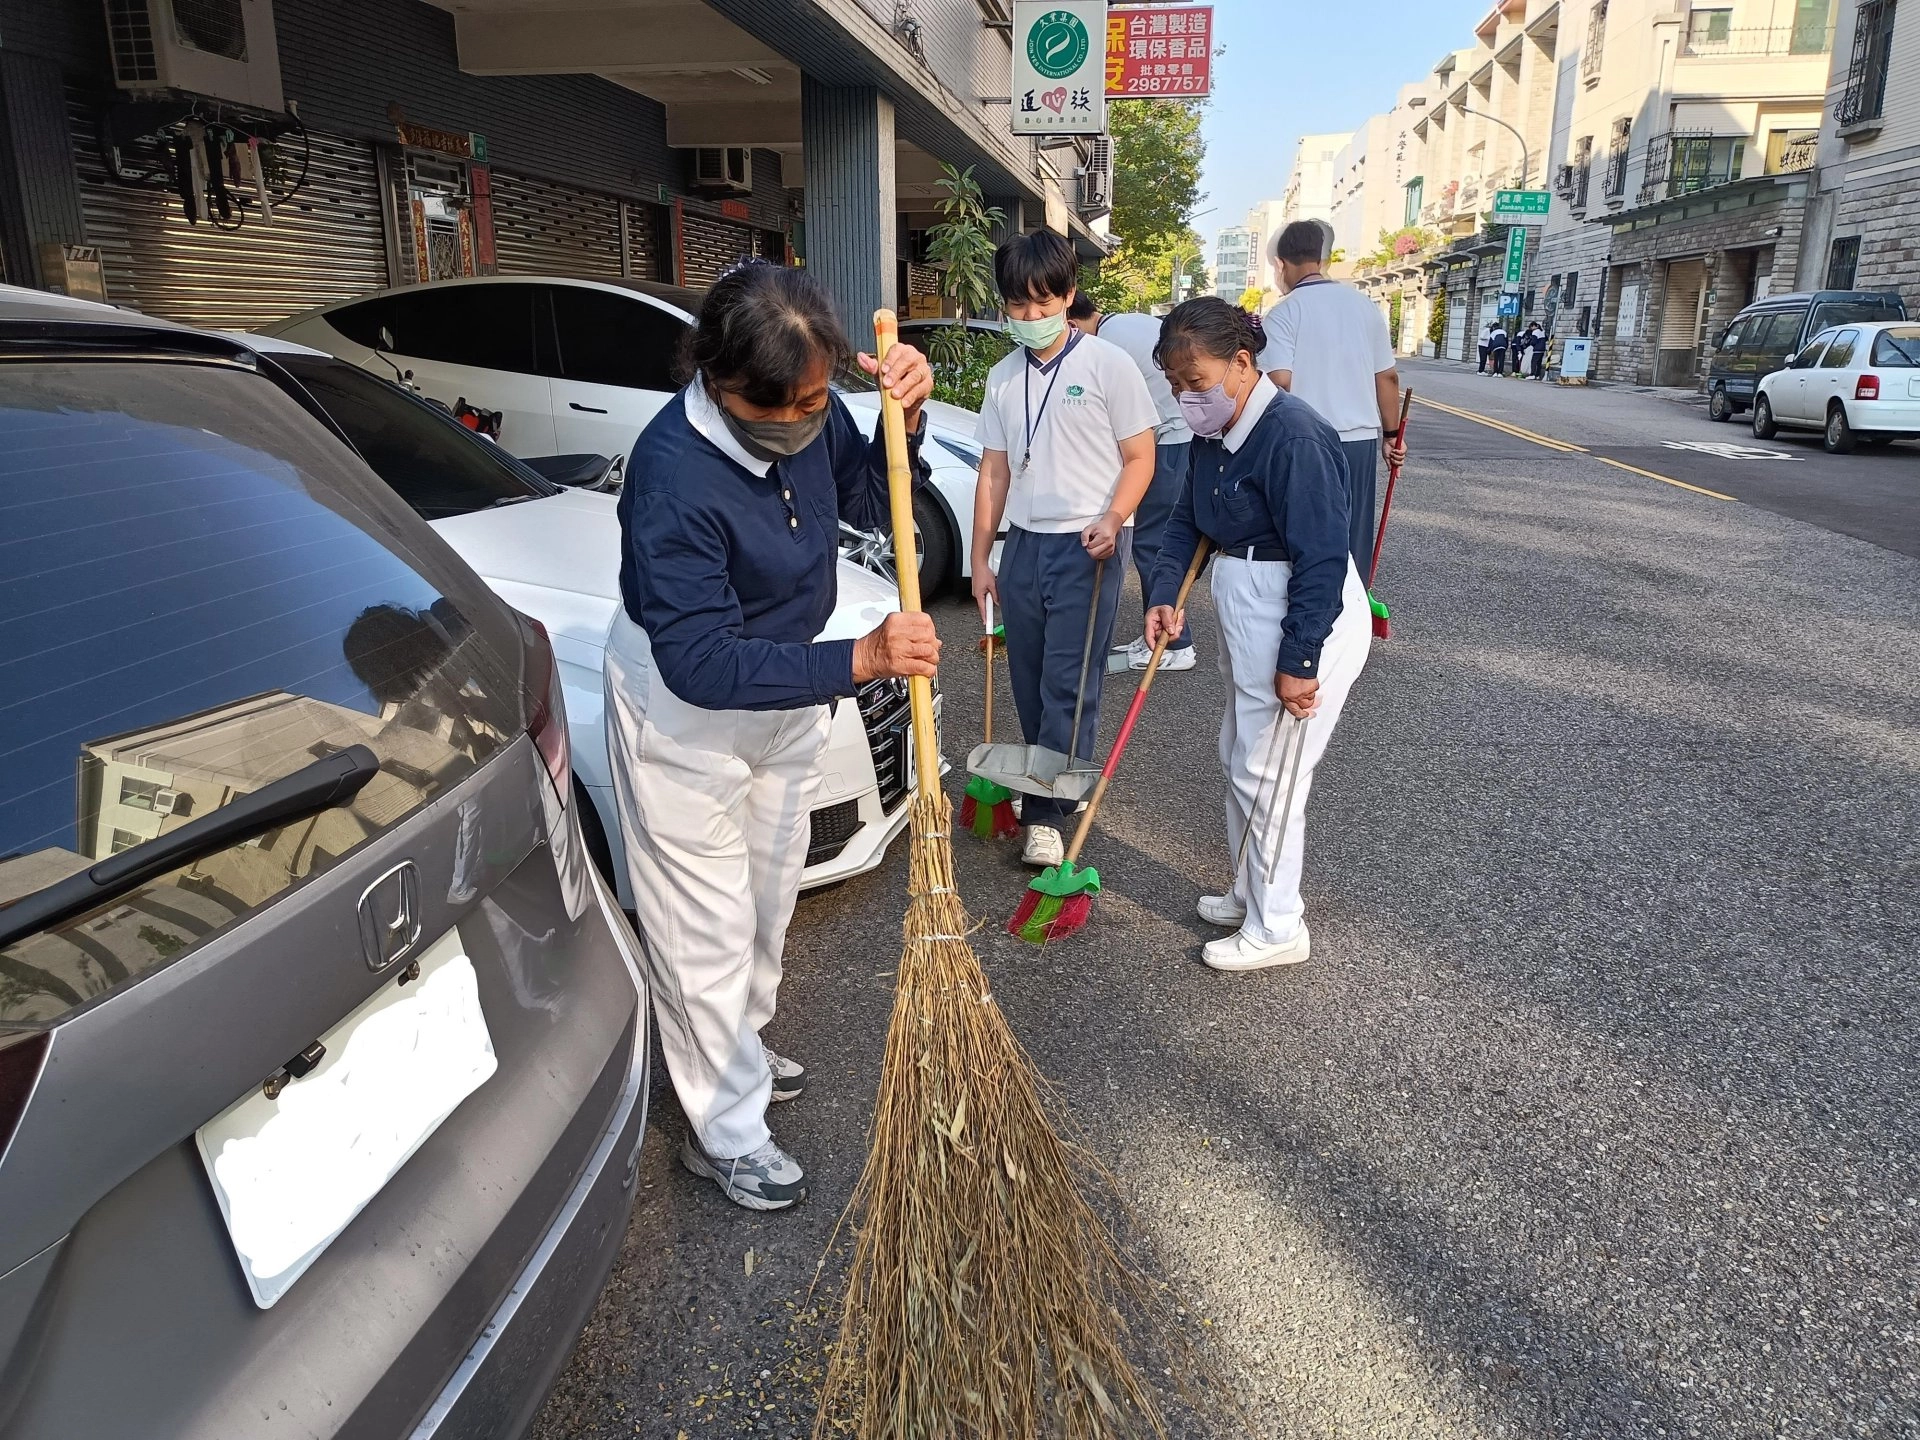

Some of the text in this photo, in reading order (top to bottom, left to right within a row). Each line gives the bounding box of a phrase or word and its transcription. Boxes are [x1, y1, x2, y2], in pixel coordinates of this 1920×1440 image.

[1129, 13, 1207, 36] 台灣製造
[1128, 37, 1207, 60] 環保香品
[1038, 62, 1079, 77] INTERNATIONAL
[1140, 63, 1194, 76] 批發零售
[1127, 76, 1205, 92] 2987757
[1501, 194, 1547, 204] 健康一街
[1499, 204, 1525, 212] Jiankang
